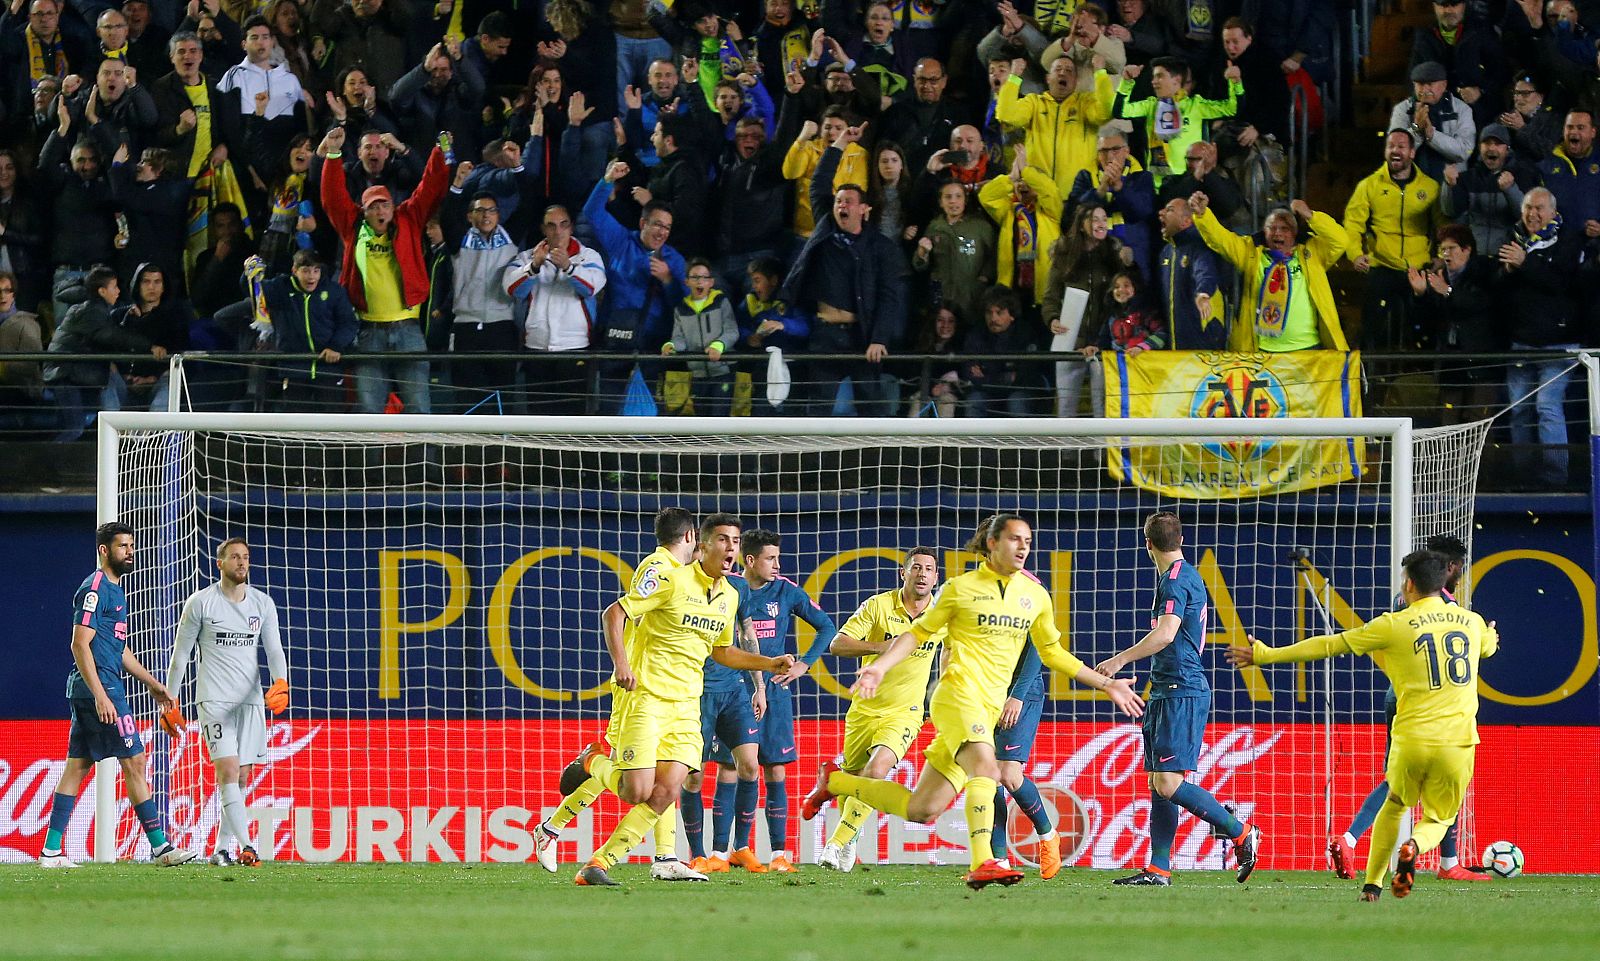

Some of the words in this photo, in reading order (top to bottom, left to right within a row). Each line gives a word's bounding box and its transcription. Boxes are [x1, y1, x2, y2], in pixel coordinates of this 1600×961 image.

[608, 328, 633, 340] SPORTS
[1137, 468, 1260, 489] VILLARREAL
[681, 614, 725, 633] PAMESA
[977, 613, 1031, 631] PAMESA
[215, 638, 254, 647] Plus500
[884, 632, 935, 651] PSA
[1413, 631, 1472, 691] 18
[115, 714, 136, 737] 18
[203, 723, 223, 741] 13
[245, 805, 594, 864] TURKISH
